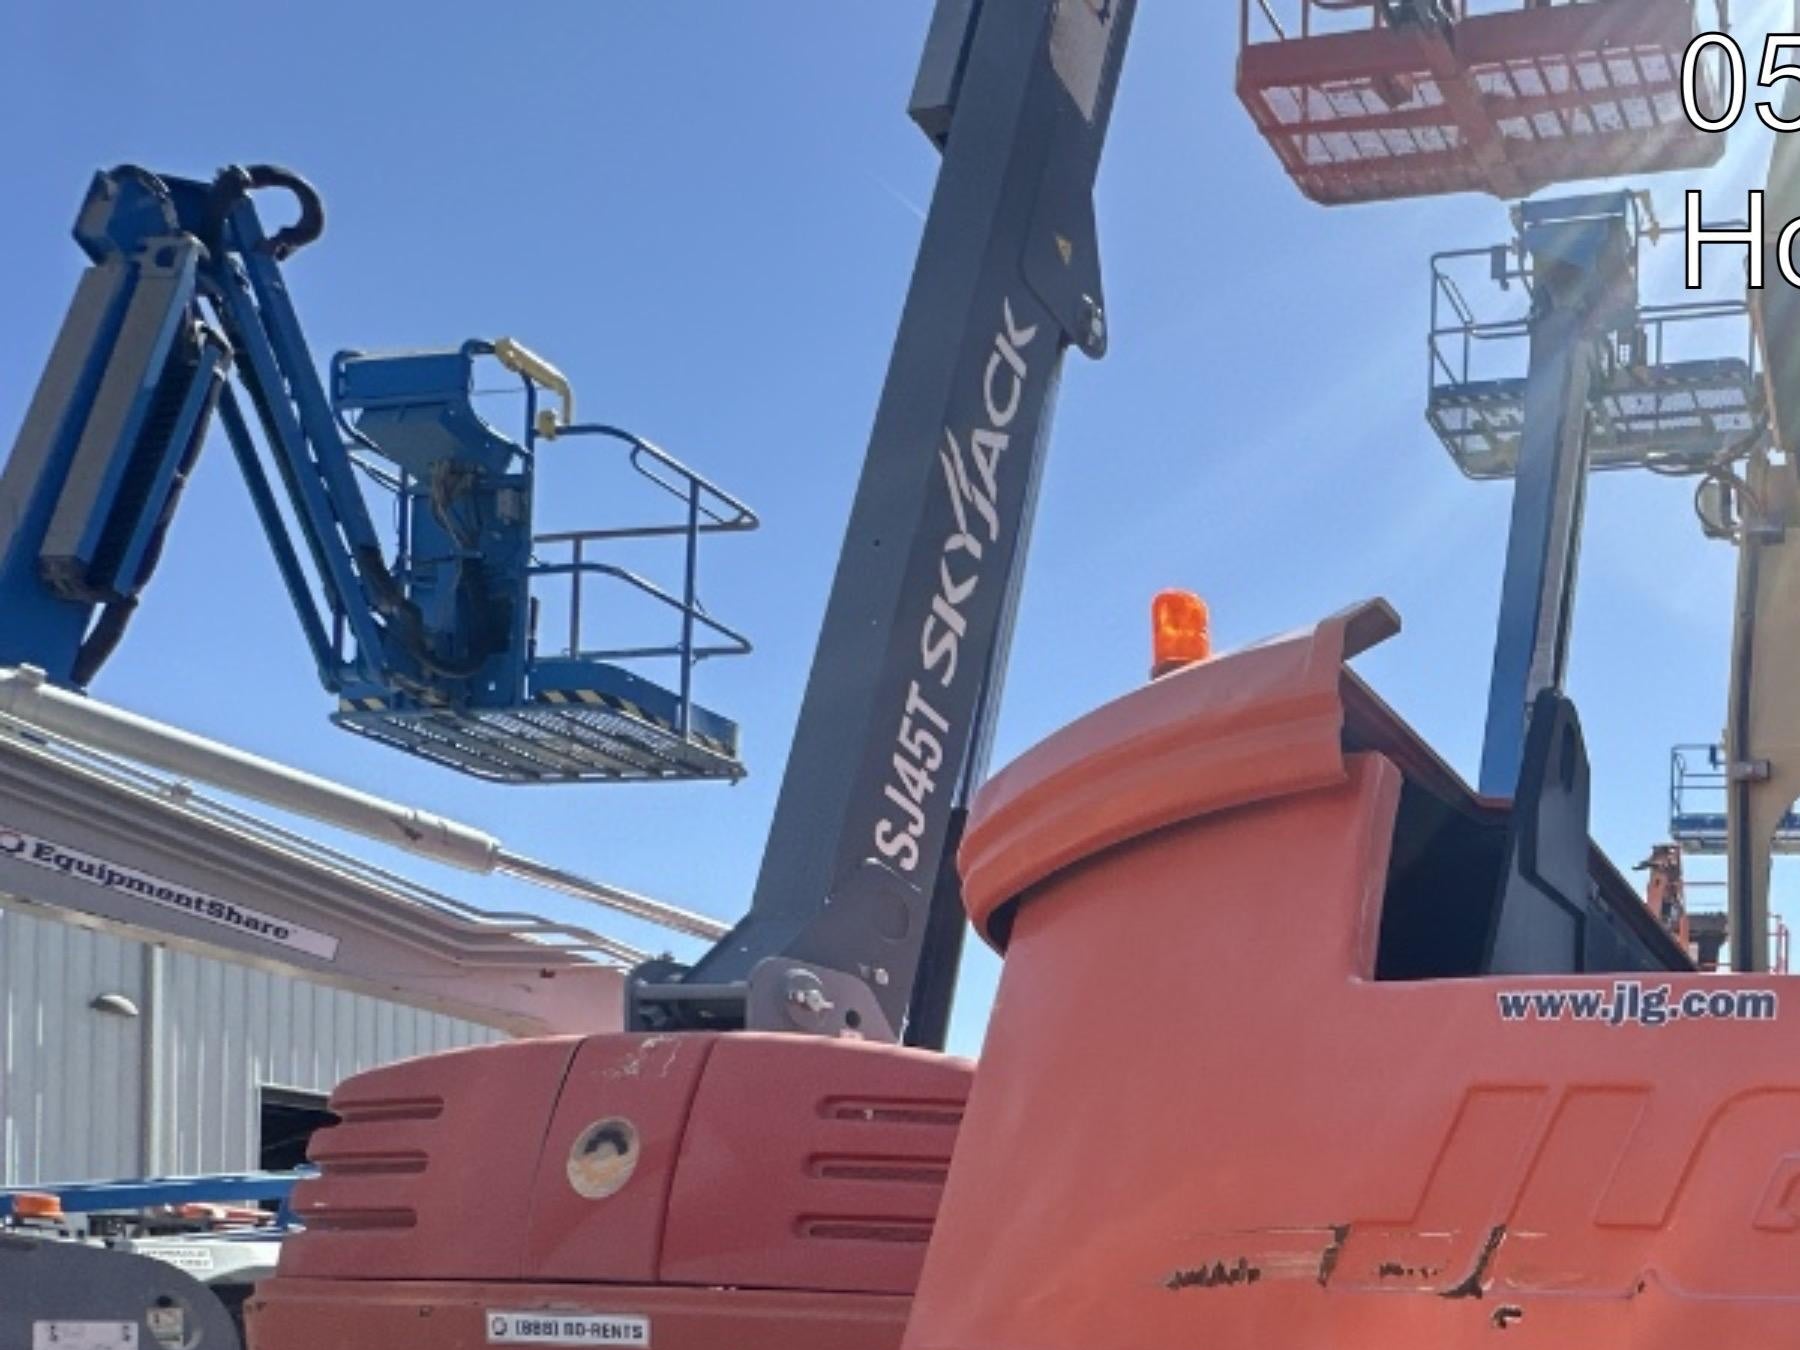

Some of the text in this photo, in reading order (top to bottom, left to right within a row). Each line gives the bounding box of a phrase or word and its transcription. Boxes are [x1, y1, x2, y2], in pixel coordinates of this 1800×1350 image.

[874, 296, 1039, 872] SJ45T SKYJACK
[32, 842, 290, 940] EquipmentShare
[1498, 982, 1777, 1025] www.jlg.com
